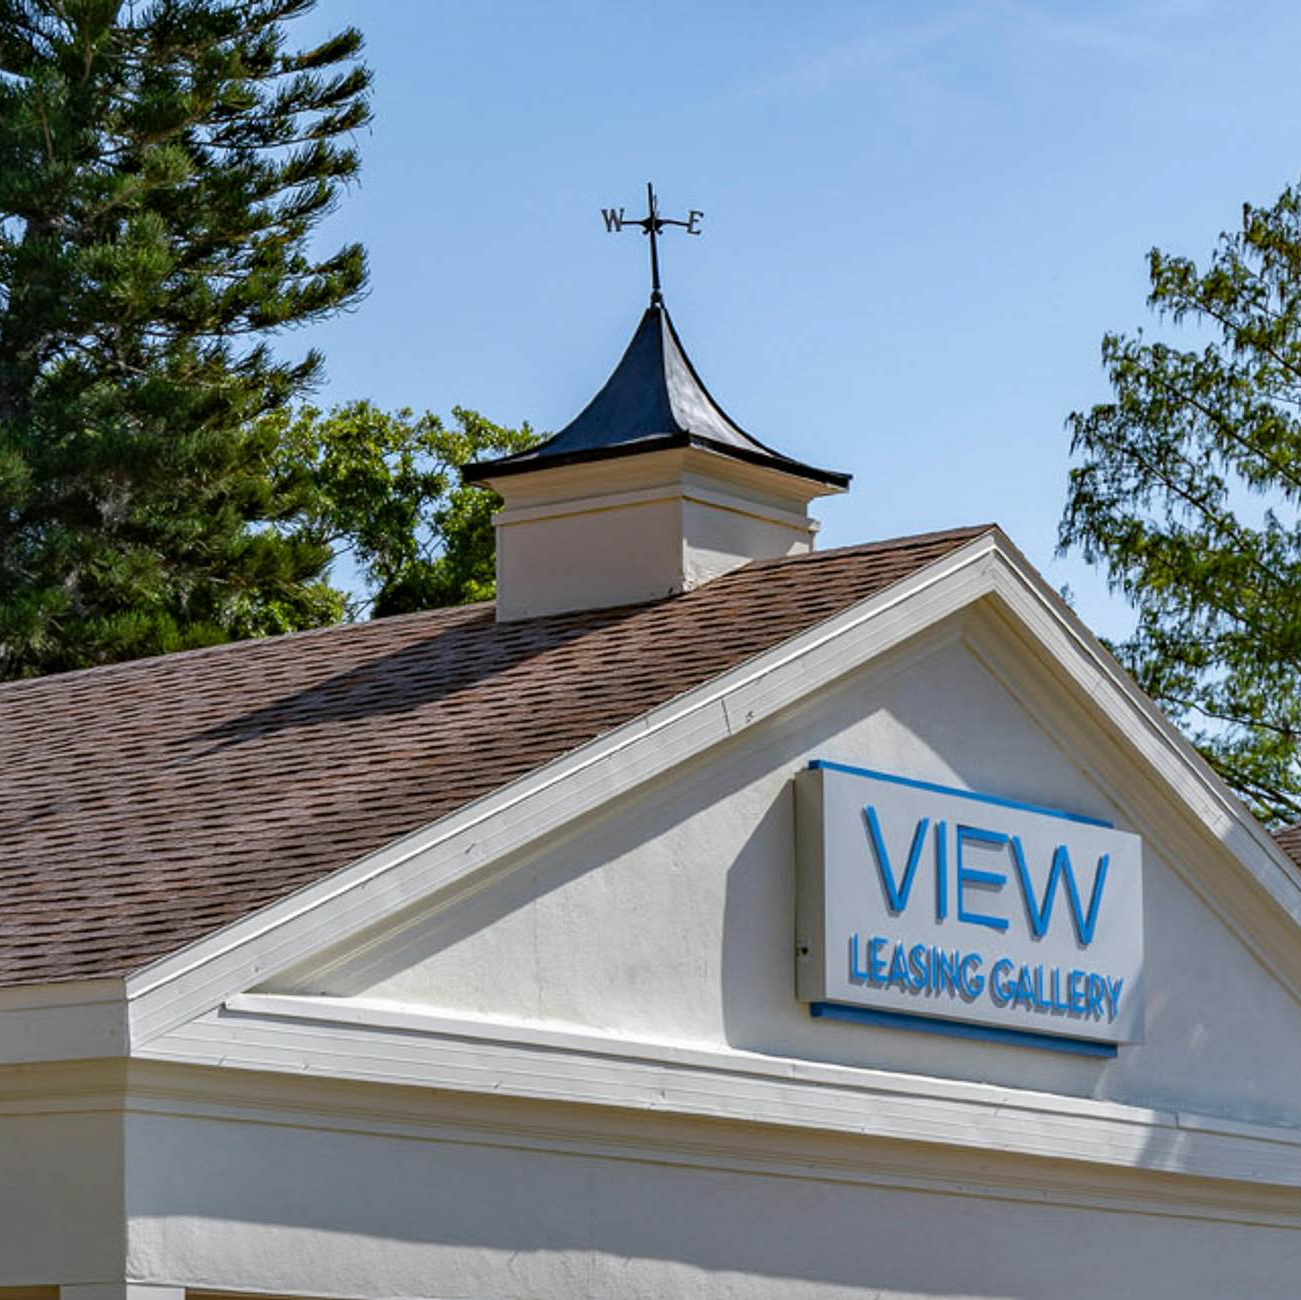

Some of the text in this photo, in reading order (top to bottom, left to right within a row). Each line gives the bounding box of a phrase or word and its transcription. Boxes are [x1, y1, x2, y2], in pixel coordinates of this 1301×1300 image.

[601, 208, 625, 232] W
[687, 210, 705, 235] E
[862, 805, 1110, 946] VIEW
[849, 932, 1124, 1018] LEASING GALLERY
